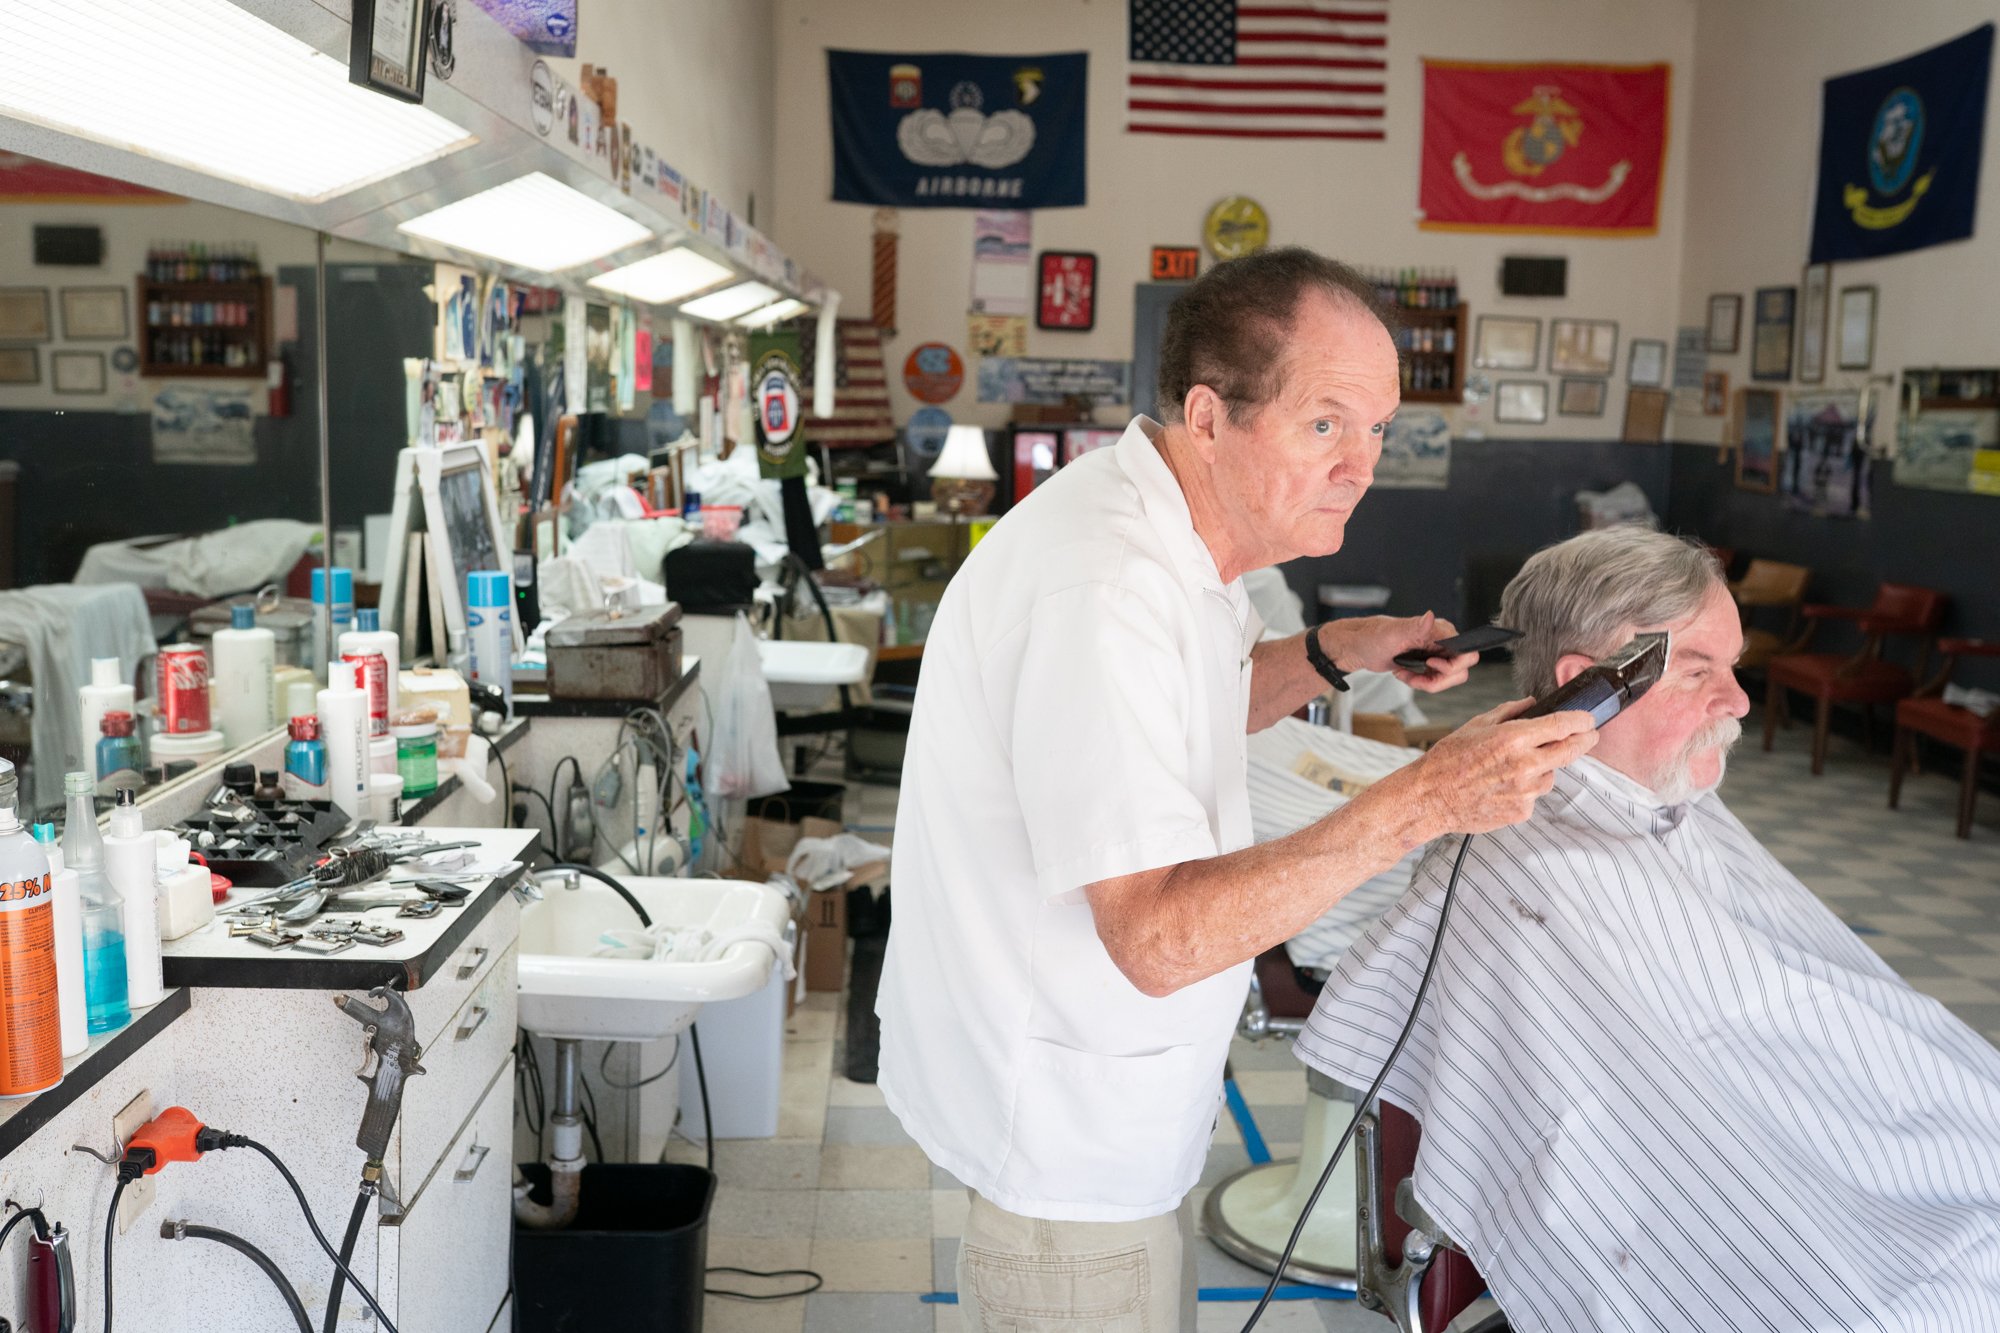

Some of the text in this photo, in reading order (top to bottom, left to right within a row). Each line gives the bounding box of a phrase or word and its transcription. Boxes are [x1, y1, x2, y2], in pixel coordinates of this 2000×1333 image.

[915, 176, 1023, 198] AIRBORNE
[1152, 249, 1197, 279] EXIT
[0, 877, 41, 901] 25%
